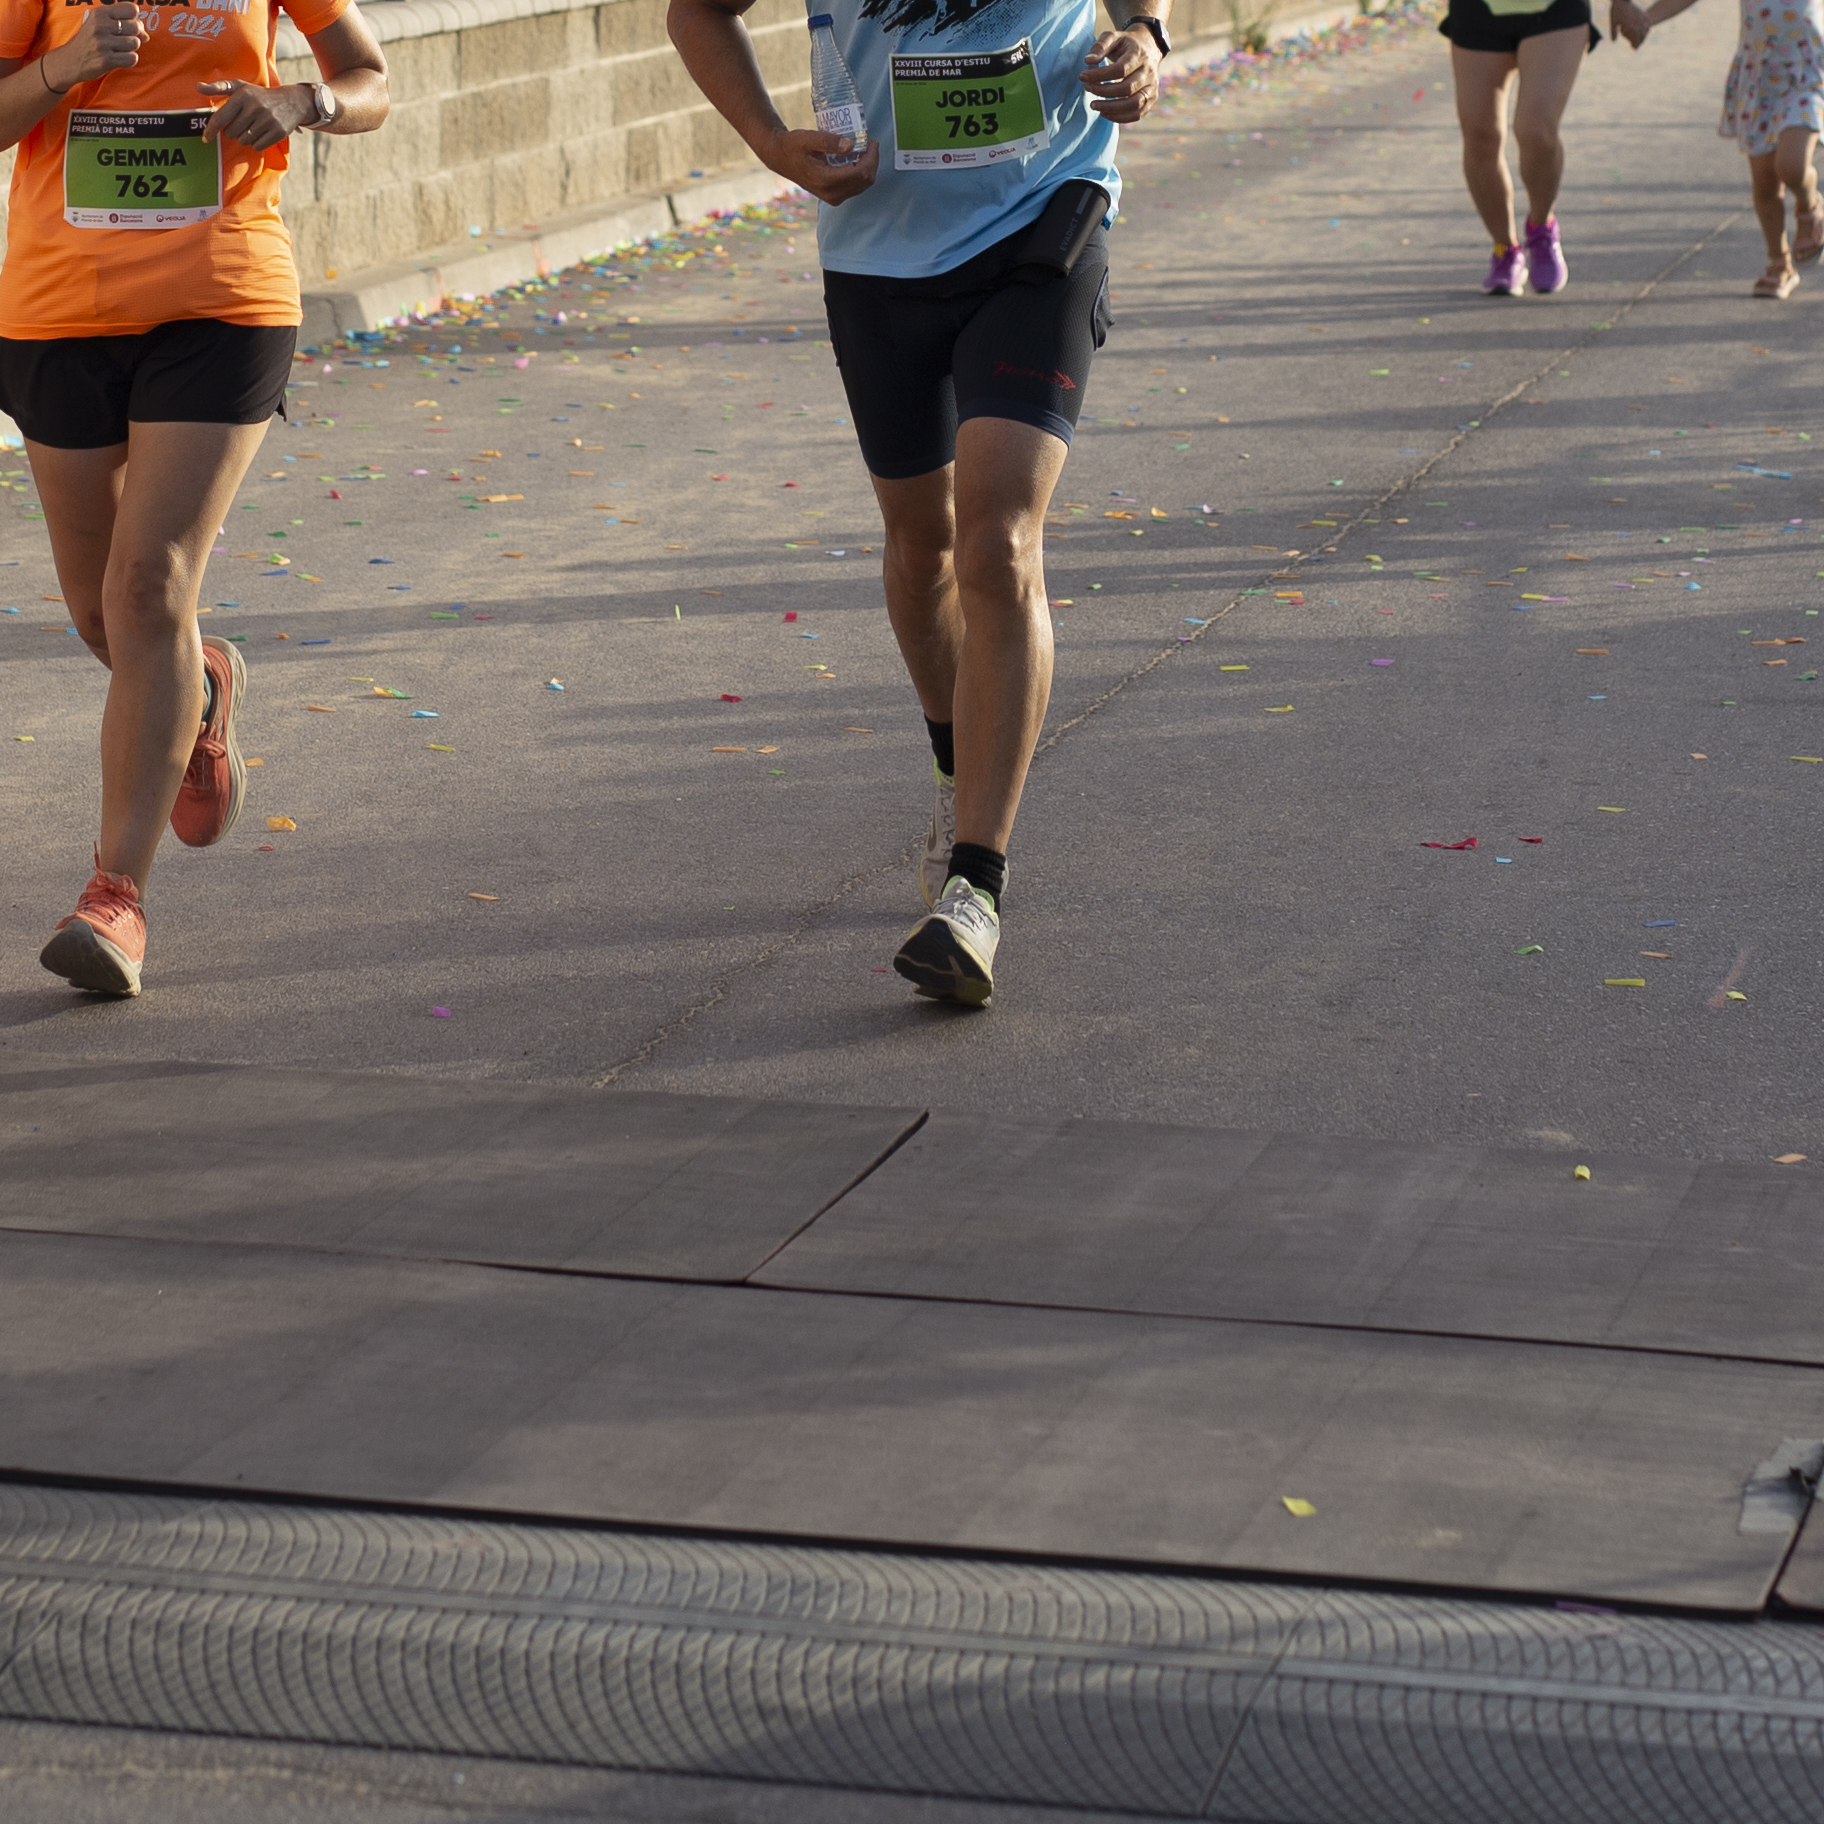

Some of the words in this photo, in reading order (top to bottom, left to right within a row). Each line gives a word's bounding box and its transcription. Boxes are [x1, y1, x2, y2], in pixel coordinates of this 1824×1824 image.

[169, 11, 227, 38] 2024
[894, 59, 922, 67] XXVIII
[924, 59, 953, 67] CURSA
[955, 57, 991, 66] D'ESTIU
[895, 67, 927, 76] PREMIÀ
[942, 68, 962, 76] MAR
[935, 87, 1005, 108] JORDI
[72, 124, 101, 134] PREMIÀ
[73, 116, 97, 124] XXVIII
[98, 116, 126, 125] CURSA
[128, 117, 165, 125] D'ESTIU
[190, 117, 207, 130] 5K
[945, 112, 999, 138] 763
[97, 148, 187, 167] GEMMA
[115, 174, 169, 198] 762
[1059, 217, 1080, 251] EVADICT
